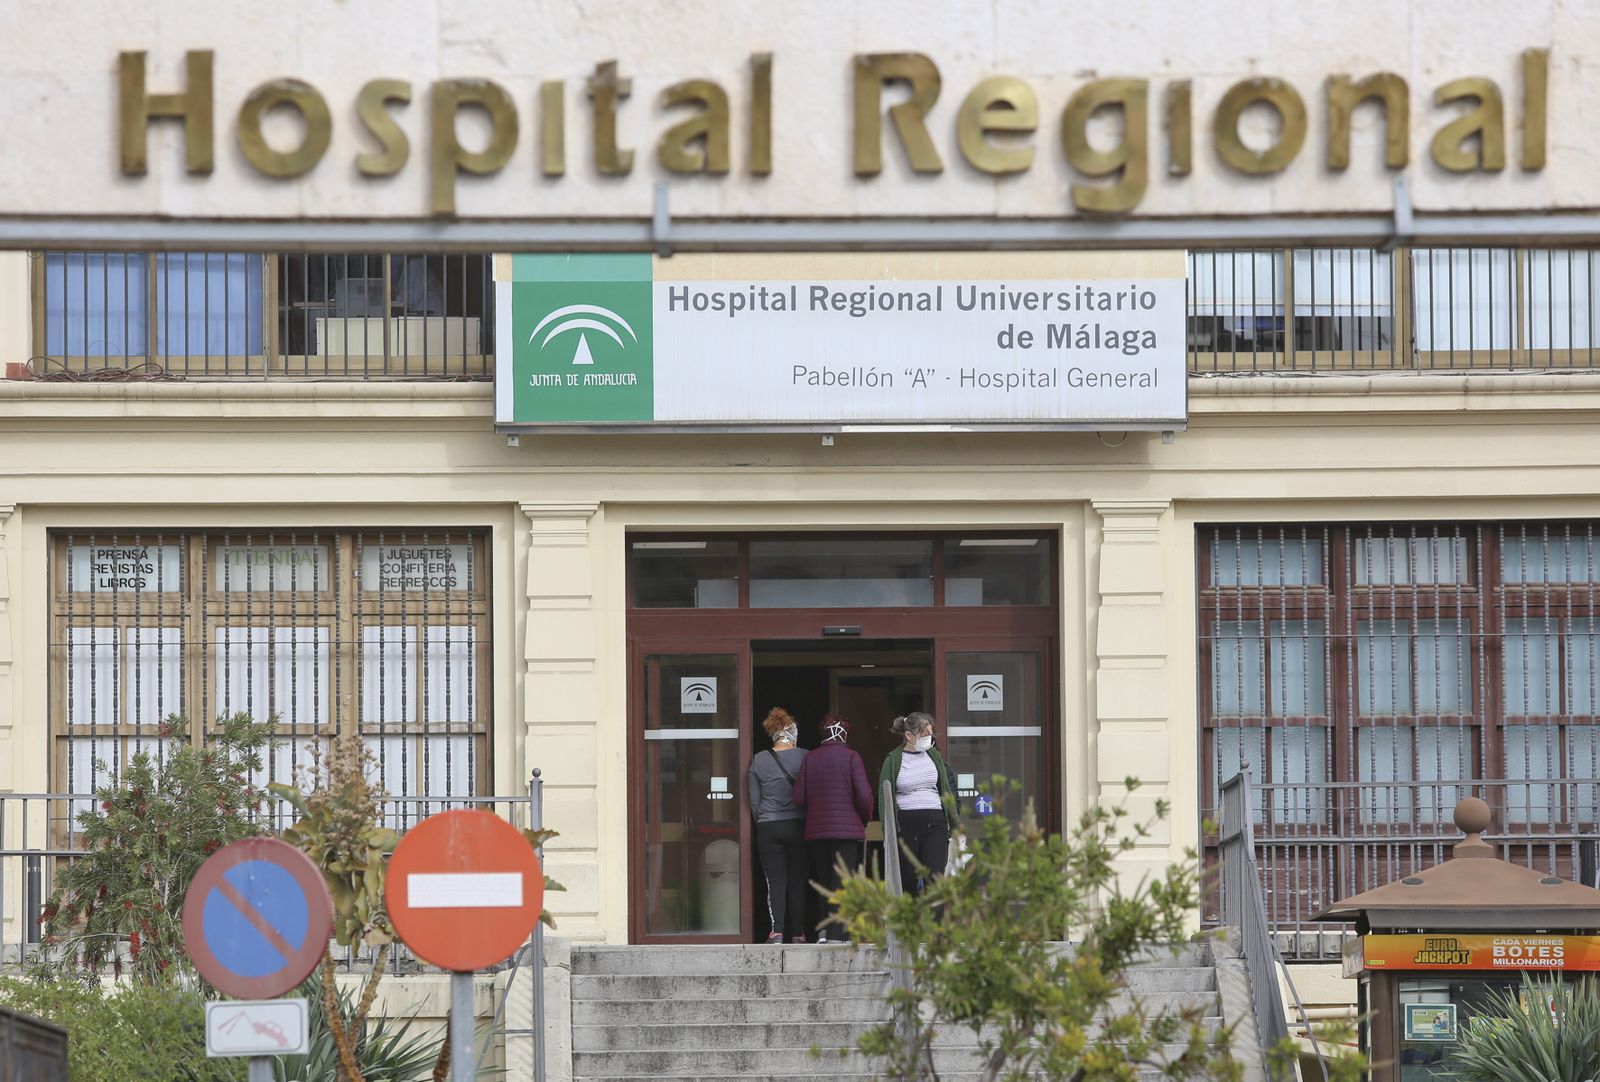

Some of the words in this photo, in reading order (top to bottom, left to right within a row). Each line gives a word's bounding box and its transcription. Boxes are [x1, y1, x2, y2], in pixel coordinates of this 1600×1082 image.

[117, 49, 774, 216] Hospital
[852, 47, 1548, 214] Regional
[668, 285, 797, 317] Hospital
[809, 285, 942, 317] Regional
[956, 284, 1157, 311] Universitario
[996, 323, 1034, 349] de
[1047, 323, 1158, 355] Málaga
[529, 374, 562, 386] JUNTA
[566, 373, 579, 386] DE
[583, 373, 637, 386] ANDALUCIA
[793, 365, 893, 388] Pabellón
[960, 367, 1057, 392] Hospital
[1067, 367, 1159, 388] General
[97, 549, 148, 560] PRENSA
[229, 549, 316, 567] TENDA
[386, 548, 452, 560] JUGUETES
[99, 577, 146, 588] LIBROS
[381, 576, 457, 588] REFRESCOS
[1424, 938, 1458, 951] EURO
[1493, 938, 1521, 946] CADA
[1523, 938, 1565, 946] VIERNES
[1414, 950, 1470, 965] JACKPOT
[1493, 945, 1565, 958] BOTES
[1492, 958, 1565, 966] MILLONARIOS
